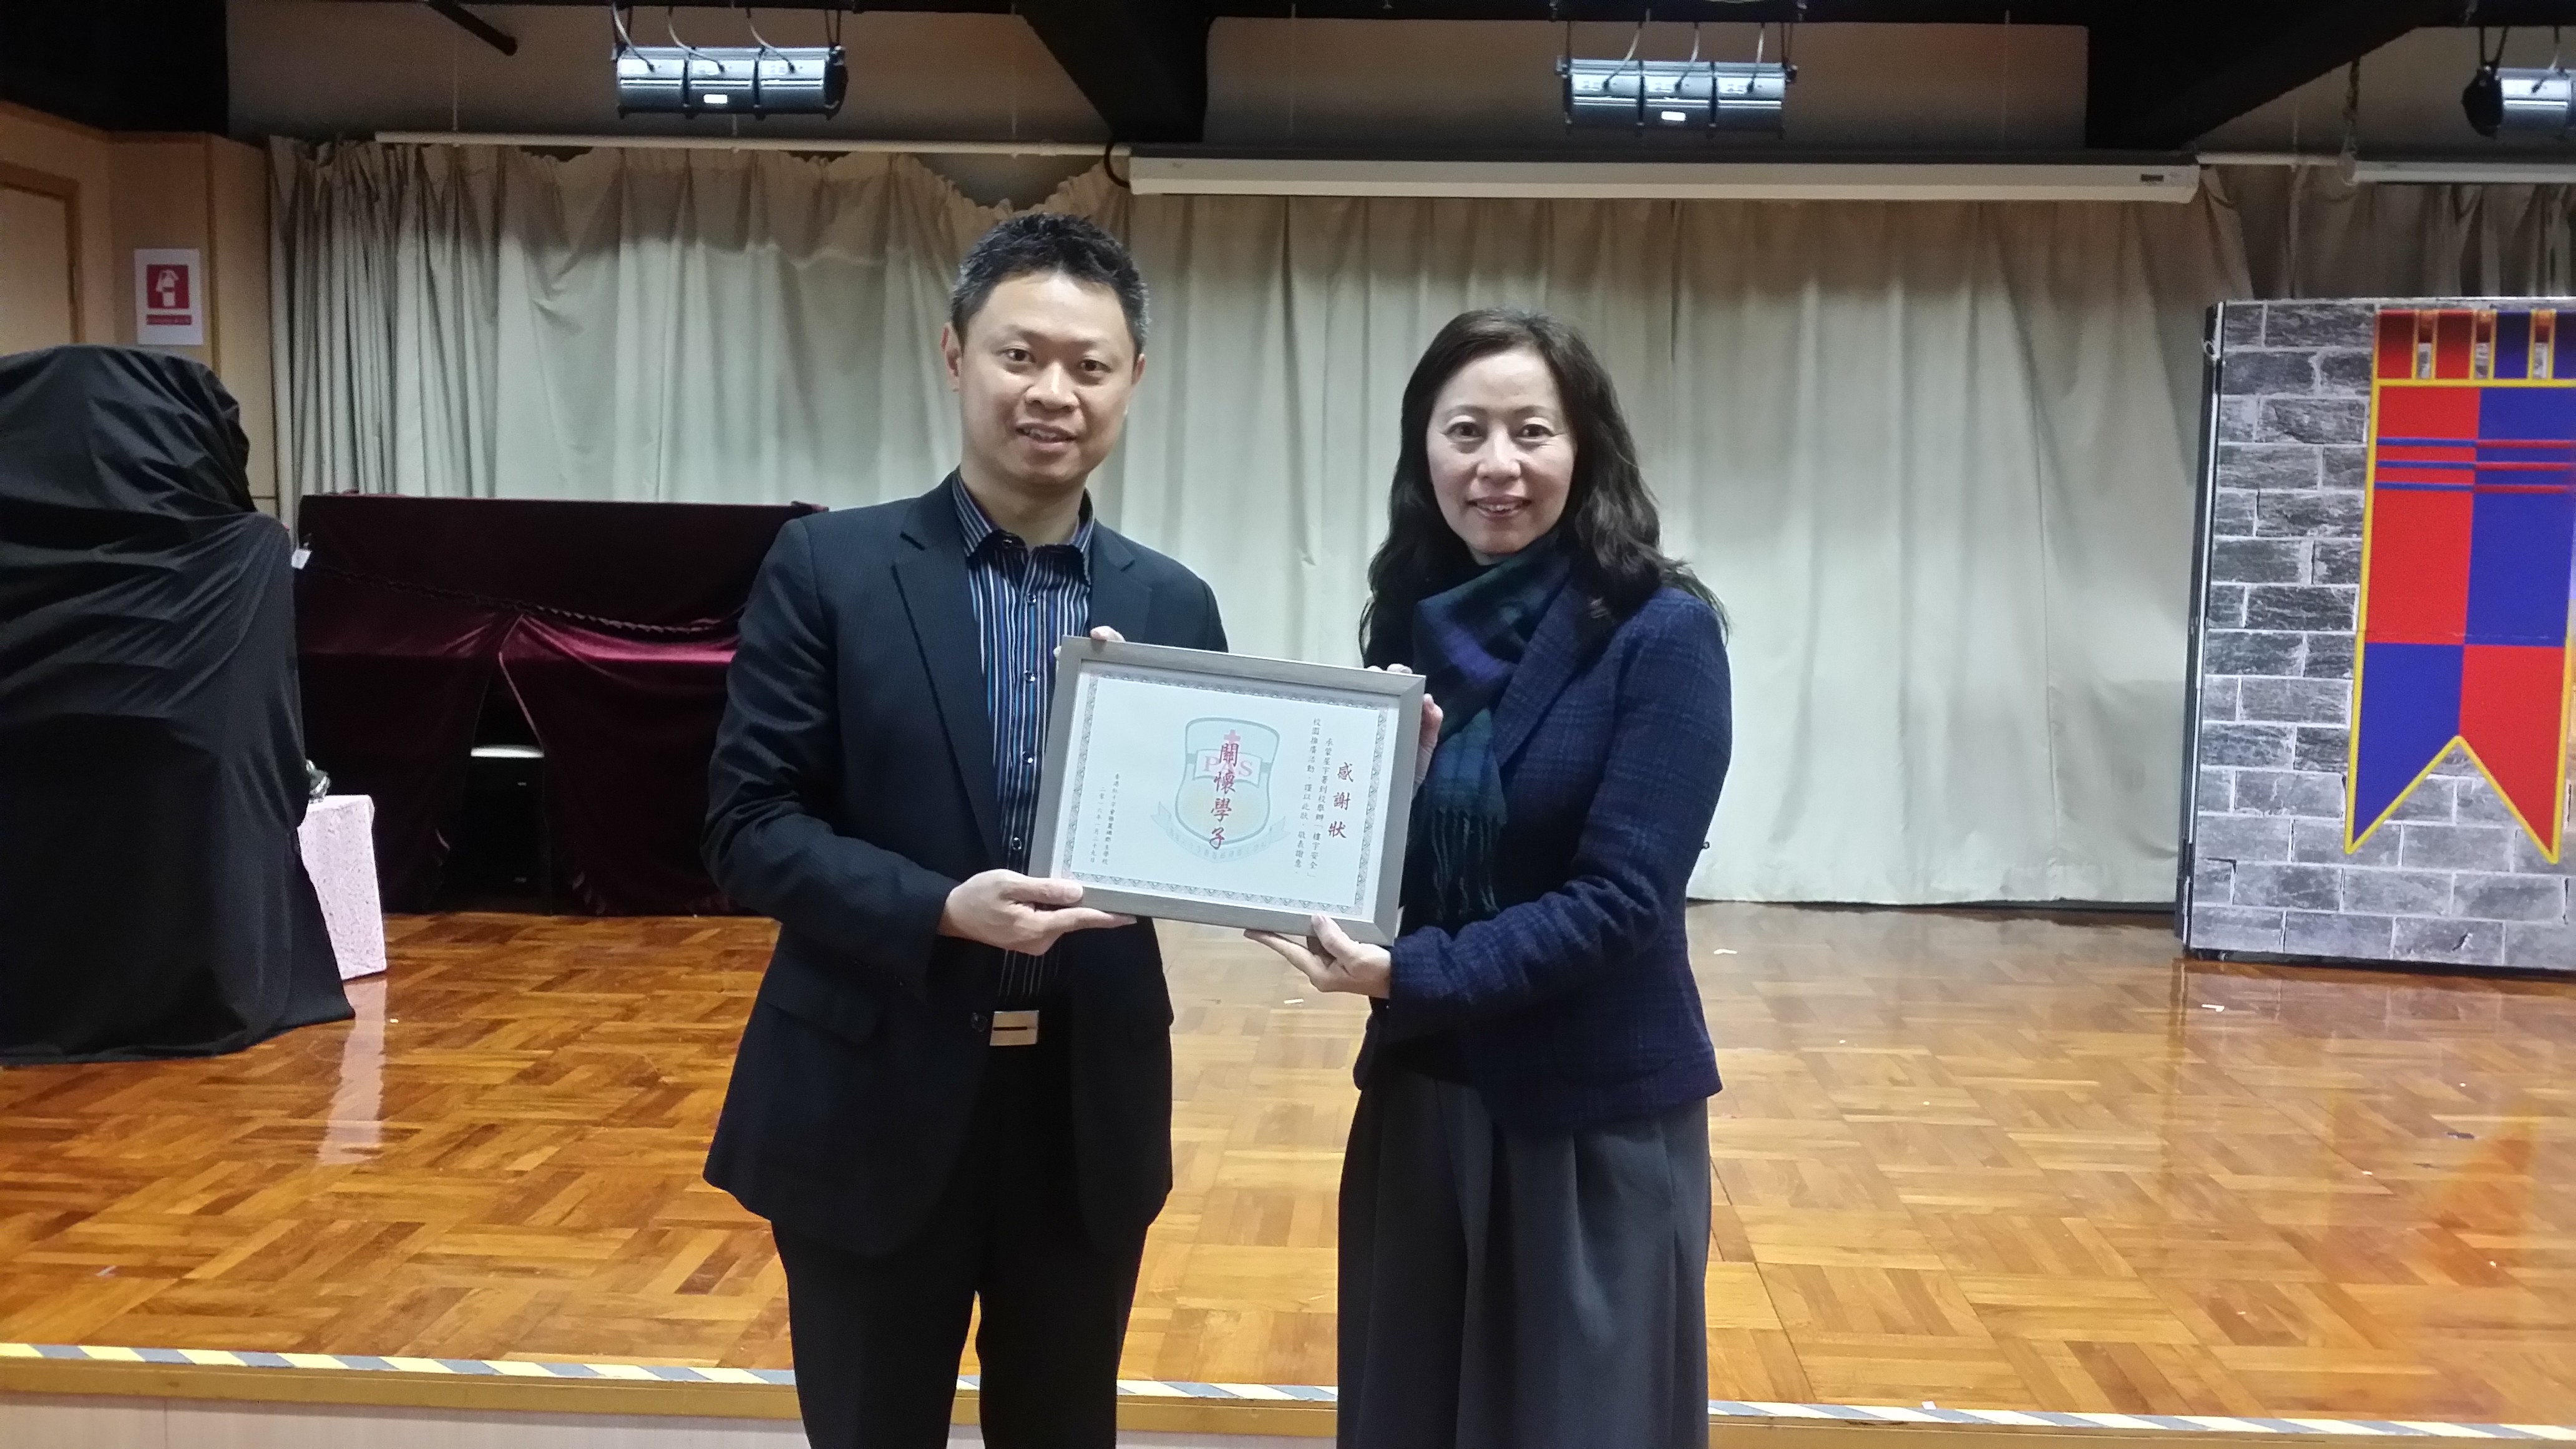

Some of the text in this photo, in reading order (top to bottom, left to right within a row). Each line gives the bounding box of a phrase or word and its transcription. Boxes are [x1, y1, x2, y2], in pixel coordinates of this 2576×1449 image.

[1209, 743, 1239, 849] 關懷學子
[1328, 762, 1354, 838] 感謝狀
